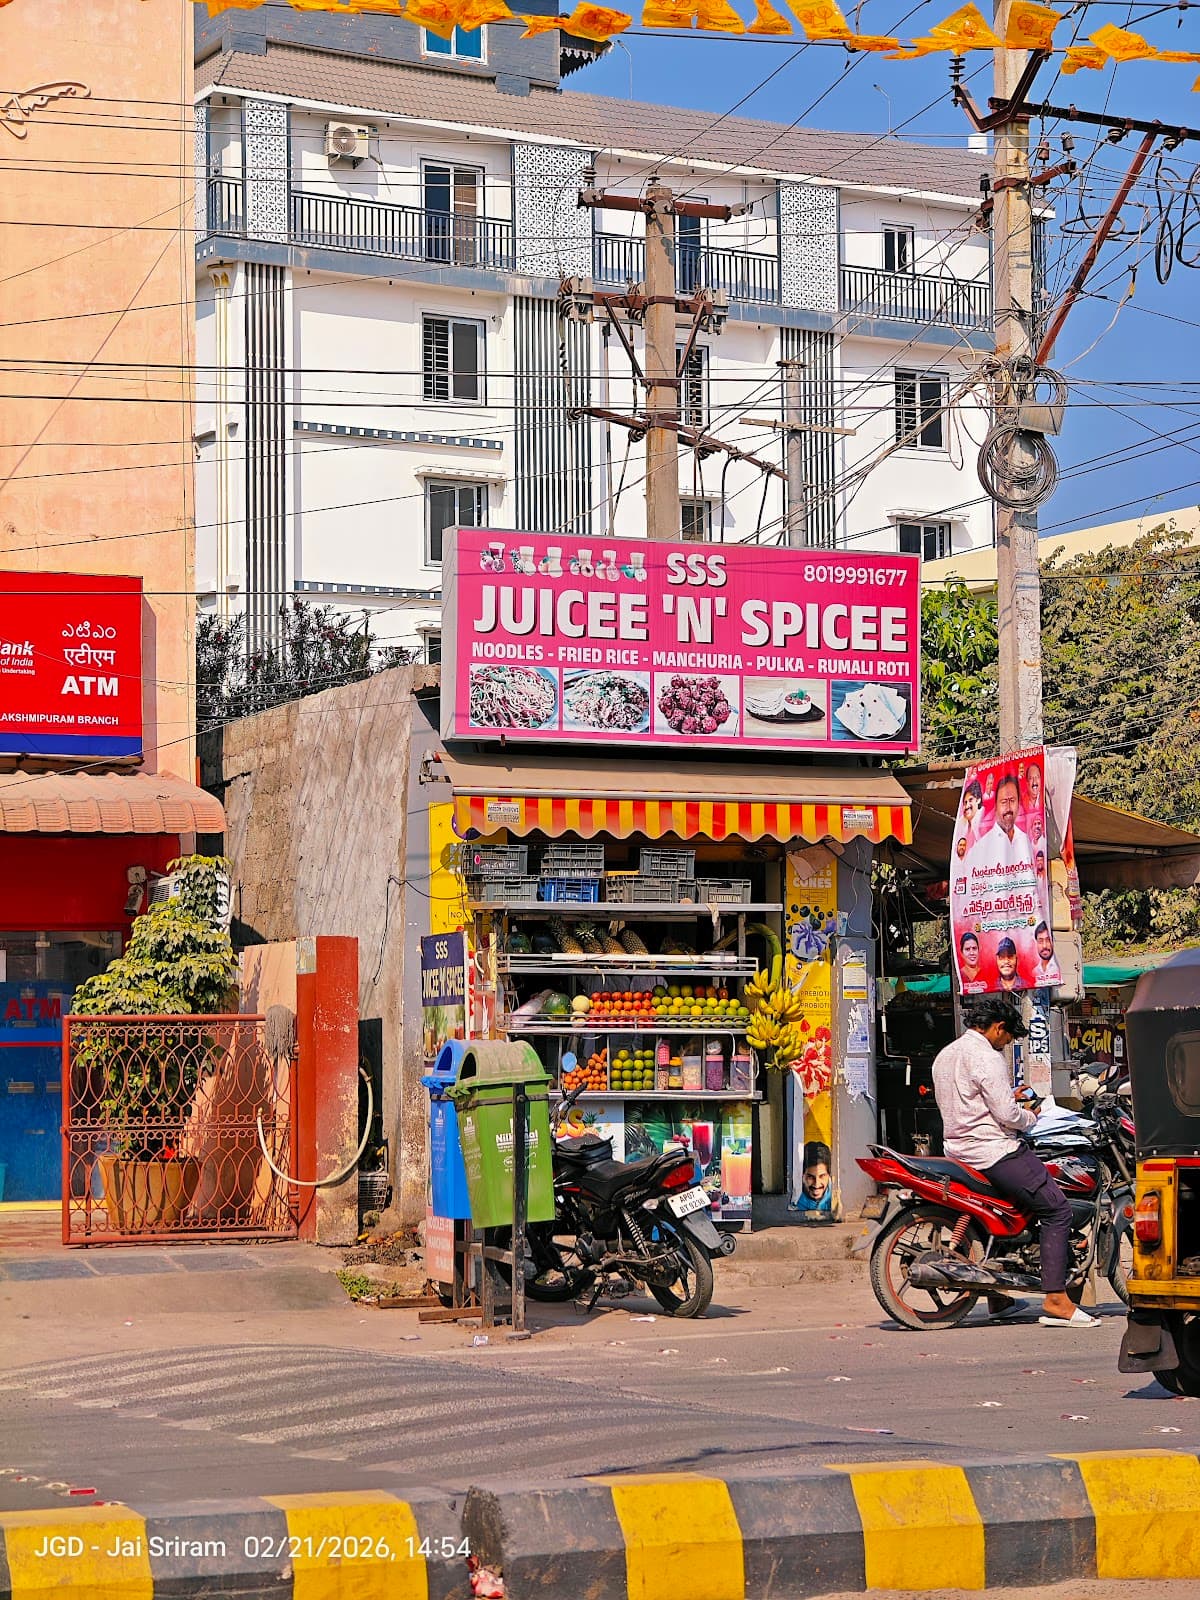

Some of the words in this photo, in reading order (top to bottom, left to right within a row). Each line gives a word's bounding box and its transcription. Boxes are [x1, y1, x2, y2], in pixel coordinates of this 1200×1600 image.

[666, 552, 727, 587] SSS
[803, 565, 908, 587] 8019991677
[473, 584, 649, 641] JUICEE
[662, 593, 728, 646] 'N'
[740, 599, 909, 653] SPICEE
[0, 640, 35, 656] ank
[63, 642, 117, 668] एटीएम
[472, 641, 544, 661] NOODLES
[558, 646, 602, 663] FRIED
[606, 648, 639, 665] RICE
[652, 650, 743, 670] MANCHURIA
[757, 655, 804, 672] PULKA
[818, 658, 873, 675] RUMALI
[877, 661, 910, 677] ROTI
[11, 657, 34, 666] India
[60, 675, 119, 697] ATM
[0, 713, 75, 724] AKSHMIPURAM
[77, 716, 119, 725] BRANCH
[435, 940, 448, 960] SSS
[4, 997, 61, 1020] ATM
[1082, 1028, 1112, 1054] Stall
